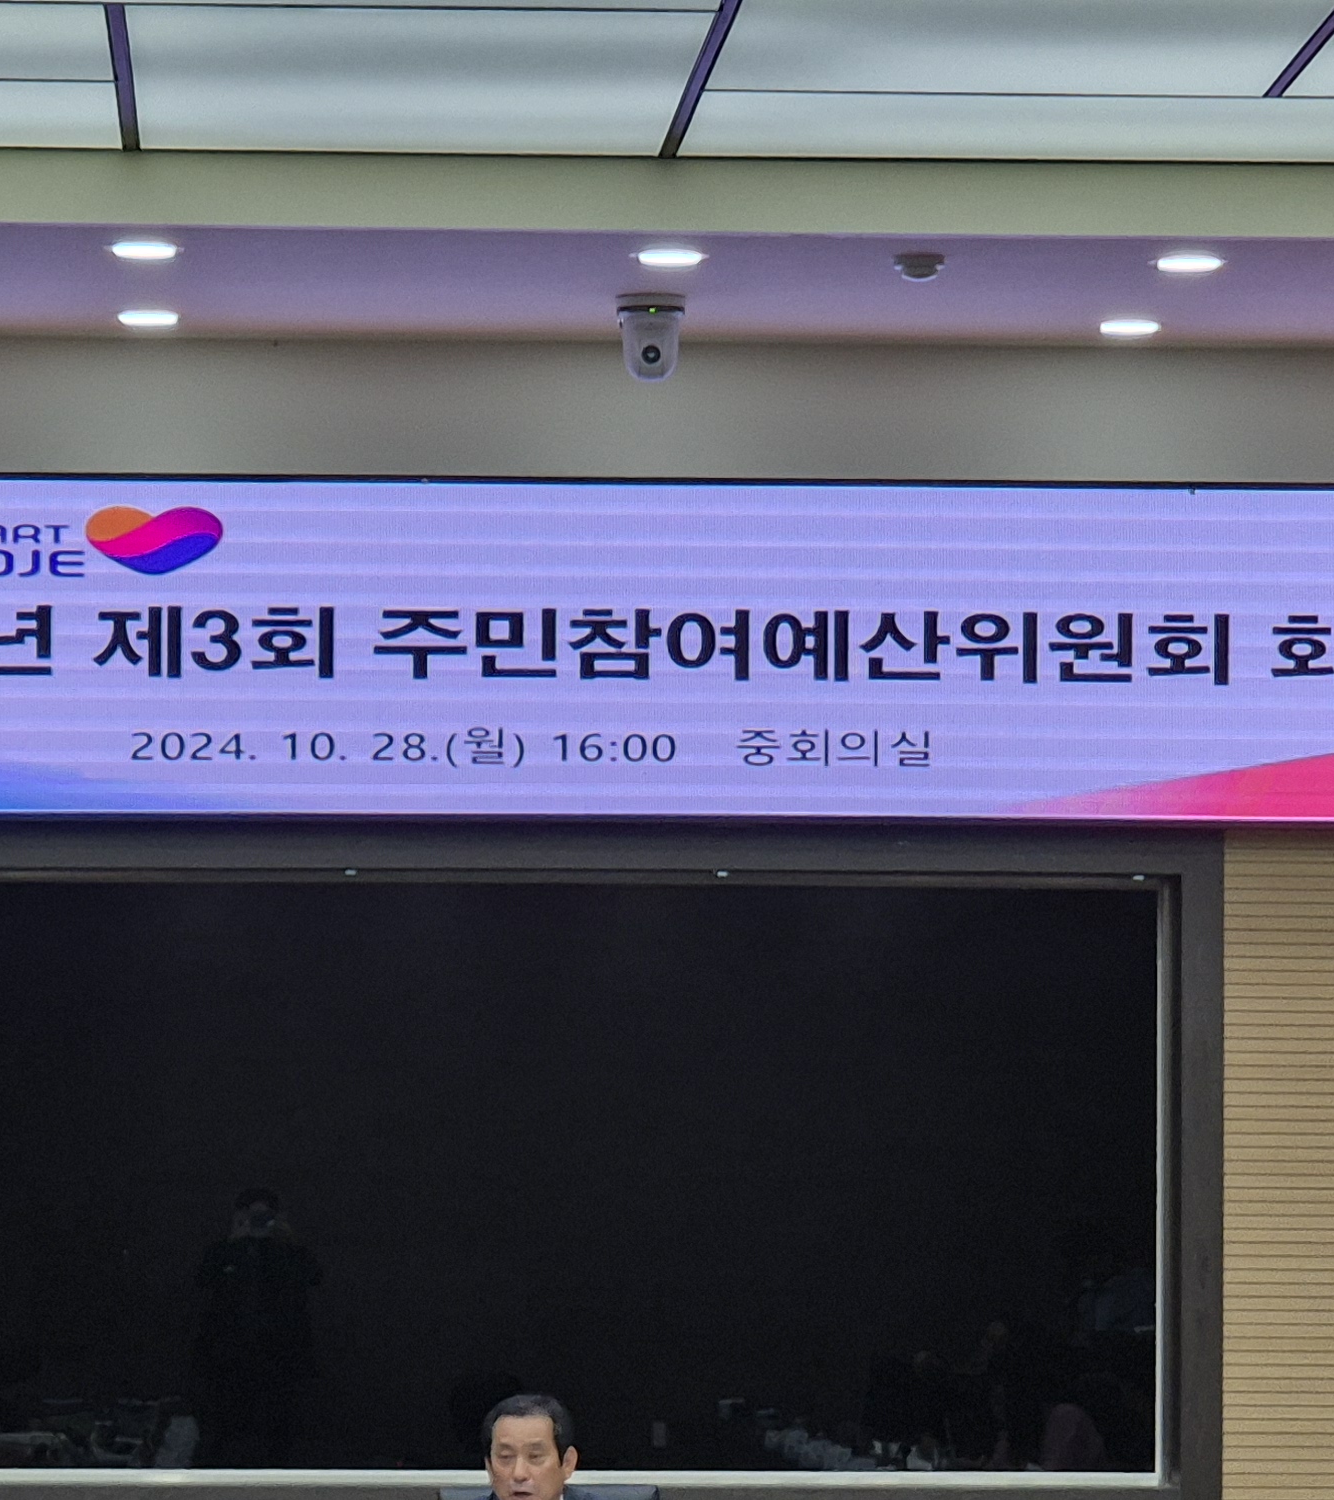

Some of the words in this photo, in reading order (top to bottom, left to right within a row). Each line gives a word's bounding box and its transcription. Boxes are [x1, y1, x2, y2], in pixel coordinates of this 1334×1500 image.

[92, 604, 337, 680] 제3회
[372, 607, 1232, 687] 주민참여예산위원회
[129, 731, 258, 762] 2024.
[281, 731, 348, 762] 10.
[370, 725, 526, 769] 28.(월)
[551, 731, 678, 763] 16:00
[735, 728, 934, 769] 중회의실
